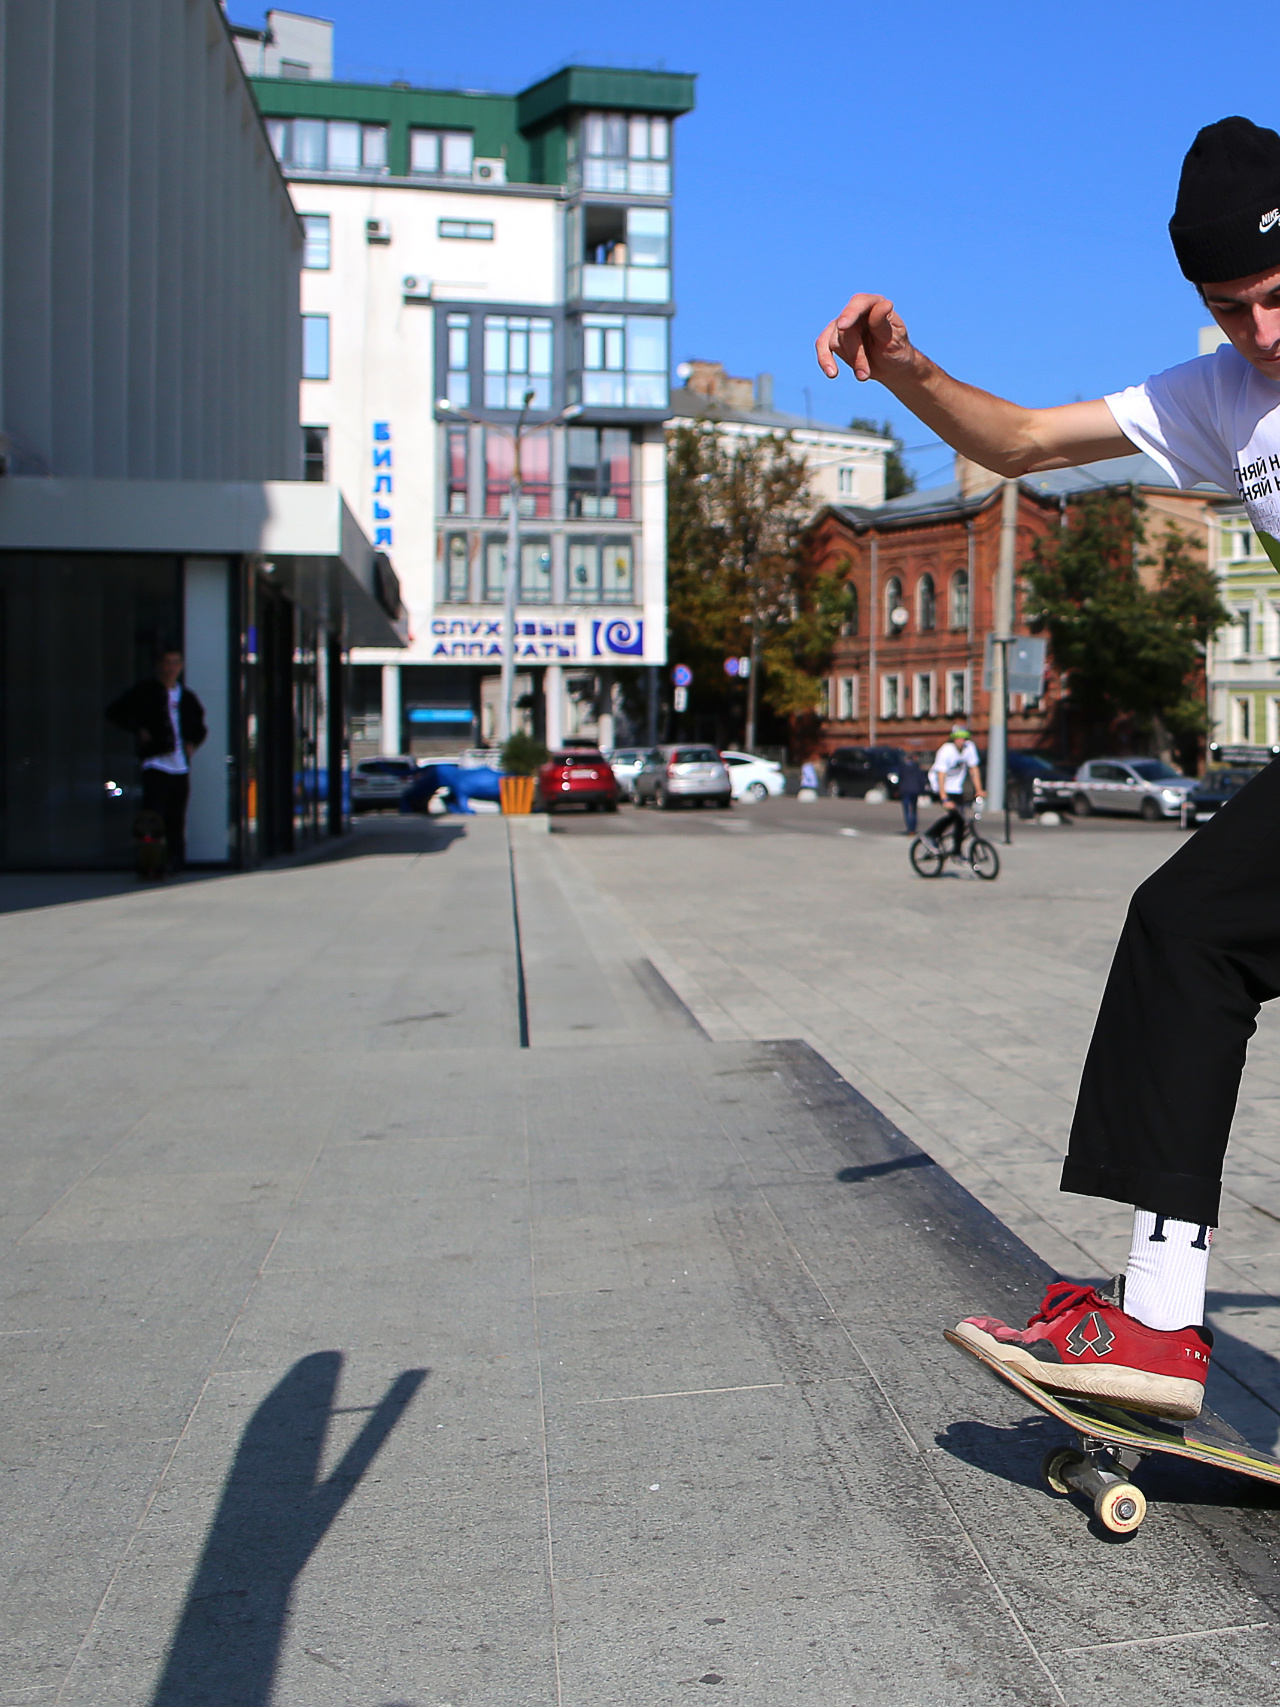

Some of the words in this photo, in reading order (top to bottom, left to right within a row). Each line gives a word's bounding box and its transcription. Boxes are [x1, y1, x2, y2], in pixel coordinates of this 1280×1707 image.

[1261, 208, 1280, 226] NIKE
[431, 620, 576, 636] СЛУХВЫЕ
[433, 642, 577, 658] АППААТЫ
